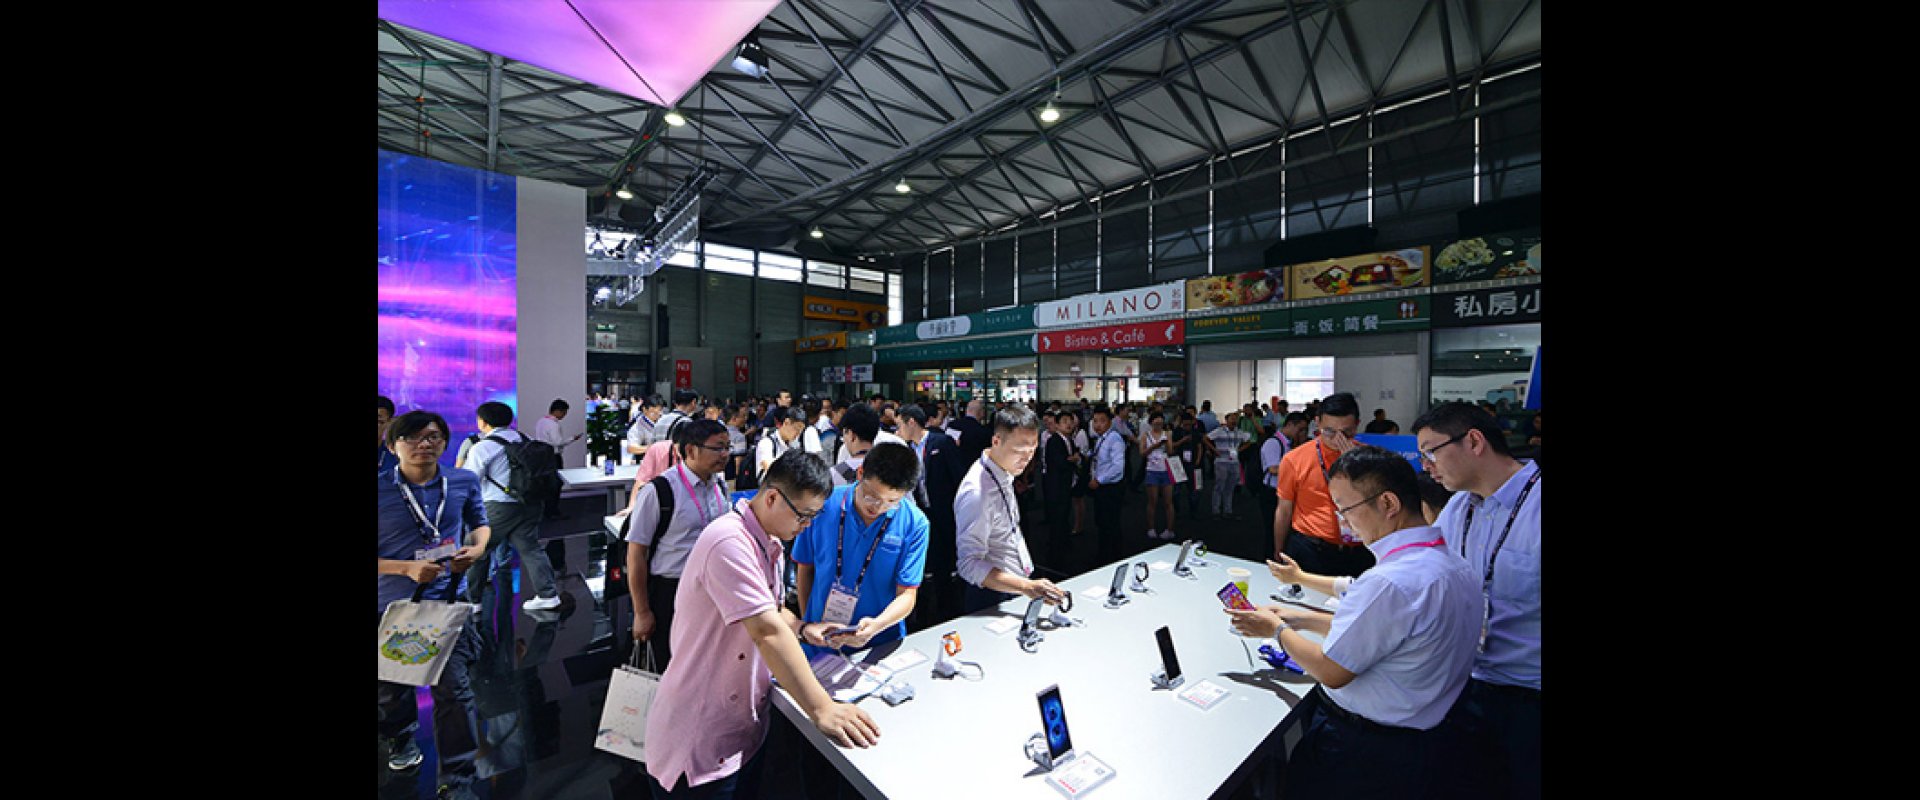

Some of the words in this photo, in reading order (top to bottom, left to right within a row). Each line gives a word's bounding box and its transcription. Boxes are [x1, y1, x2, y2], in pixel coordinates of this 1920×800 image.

[1056, 291, 1162, 320] MILANO
[1064, 333, 1099, 348] Bistro
[1100, 332, 1110, 345] &
[1112, 328, 1146, 345] Café
